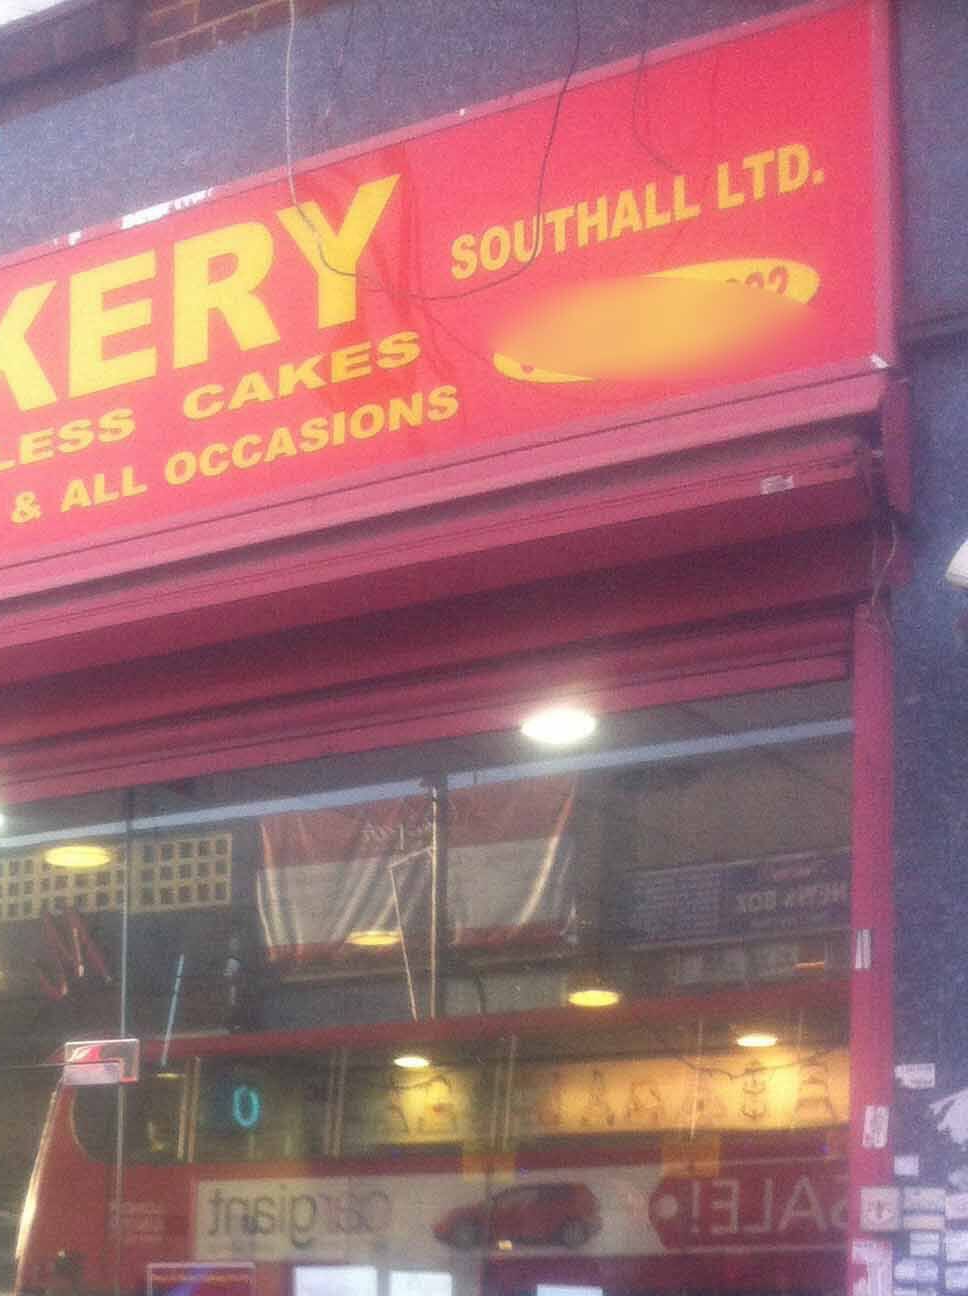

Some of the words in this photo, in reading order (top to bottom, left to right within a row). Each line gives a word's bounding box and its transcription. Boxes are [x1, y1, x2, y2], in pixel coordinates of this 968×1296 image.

[450, 175, 701, 279] SOUTHALL
[716, 142, 825, 211] LTD.
[182, 330, 421, 421] CAKES
[10, 491, 42, 525] &
[60, 465, 148, 514] ALL
[163, 384, 459, 487] OCCASIONS
